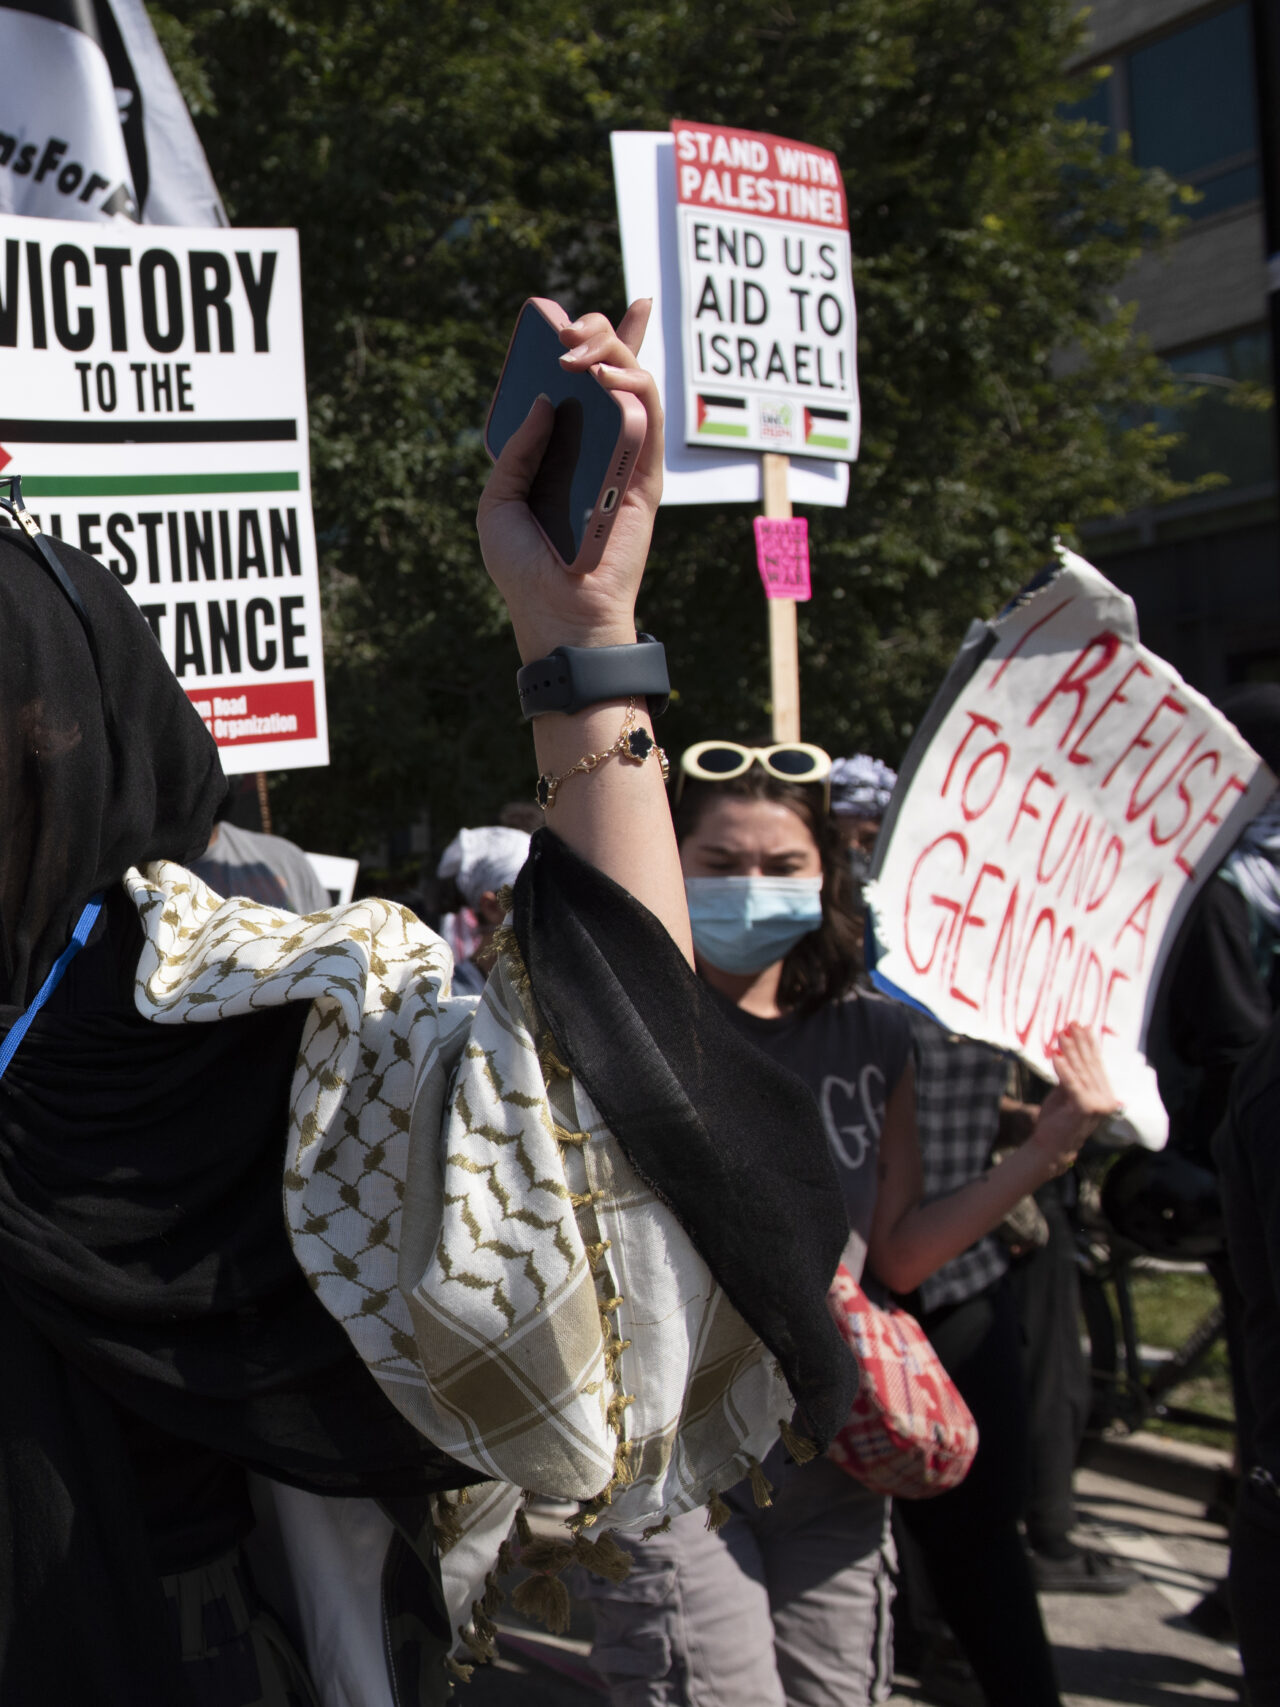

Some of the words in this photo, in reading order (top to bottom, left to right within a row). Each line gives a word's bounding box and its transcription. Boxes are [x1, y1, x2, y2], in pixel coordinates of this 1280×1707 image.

[677, 130, 769, 172] STAND
[775, 145, 838, 187] WITH
[680, 166, 843, 224] PALESTINE!
[694, 222, 765, 269] END
[784, 236, 837, 281] U.S
[696, 275, 769, 325] AID
[790, 287, 843, 337] TO
[75, 361, 118, 413] TO
[130, 362, 195, 412] THE
[698, 332, 846, 391] ISRAEL!
[213, 694, 247, 718] Road
[214, 712, 298, 740] Organization
[1026, 631, 1248, 882] REFUSE
[939, 710, 1011, 823] TO
[1007, 765, 1125, 915] FUND
[1112, 870, 1164, 975] A
